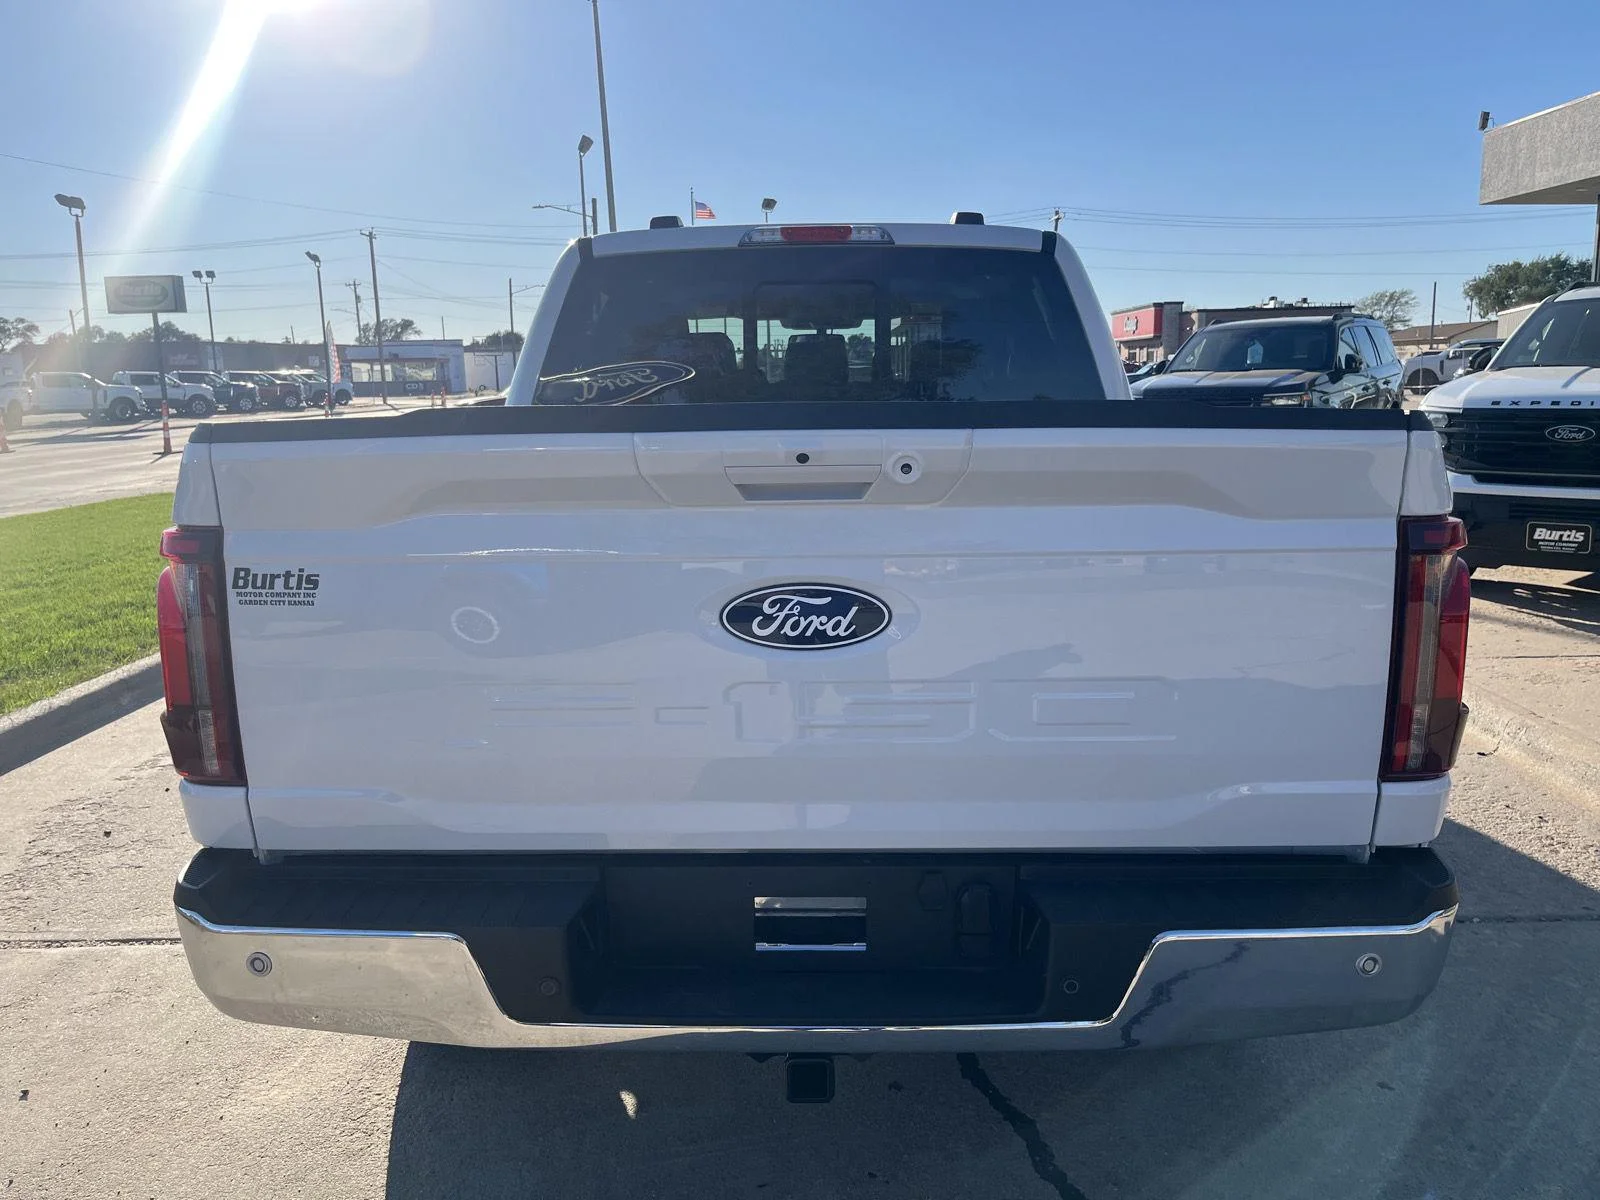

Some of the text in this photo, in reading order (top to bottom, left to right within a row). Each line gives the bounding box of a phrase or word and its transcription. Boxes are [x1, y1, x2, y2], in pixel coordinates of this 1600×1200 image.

[1554, 427, 1586, 439] Ford
[1533, 527, 1585, 542] Burtis
[231, 567, 320, 590] Burtis
[751, 594, 859, 637] Ford
